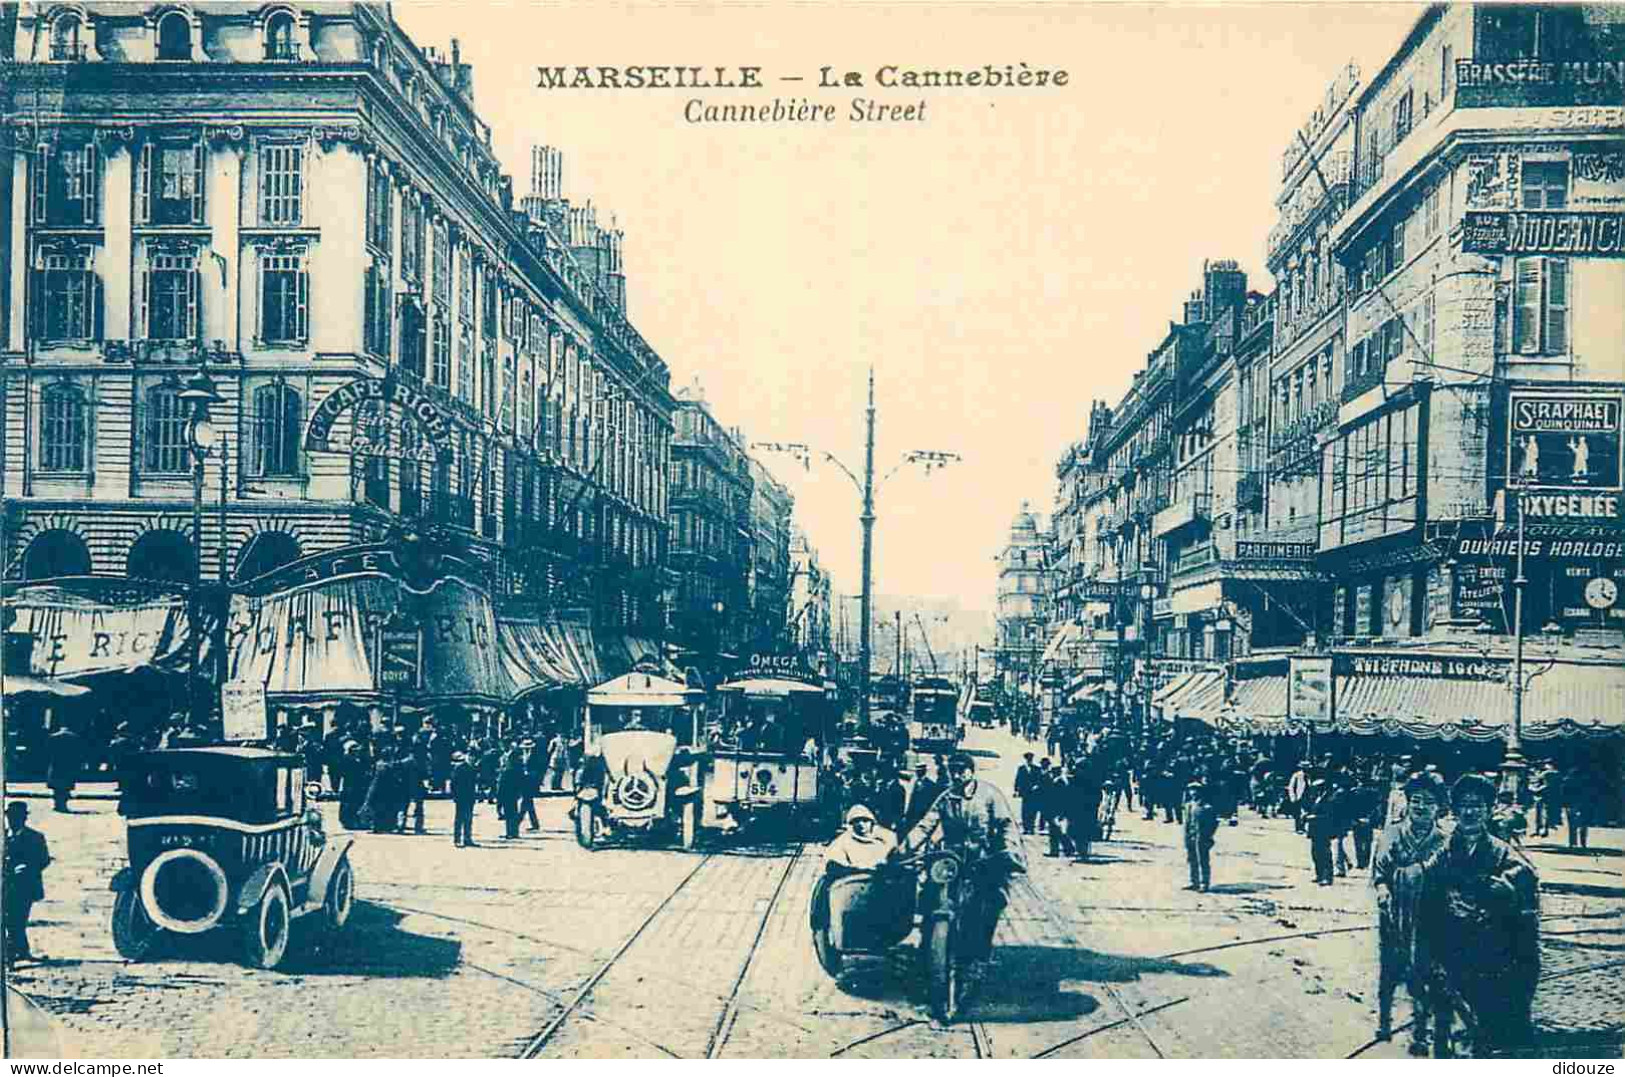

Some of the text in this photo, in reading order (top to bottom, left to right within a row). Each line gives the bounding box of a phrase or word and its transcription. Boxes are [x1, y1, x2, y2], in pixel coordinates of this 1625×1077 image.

[1458, 61, 1555, 86] BRASSERIE
[1538, 402, 1614, 429] RAPHAEL
[1535, 419, 1602, 431] QUINQUINA
[1238, 544, 1314, 559] PARFUMERIE
[750, 653, 799, 669] OMEGA
